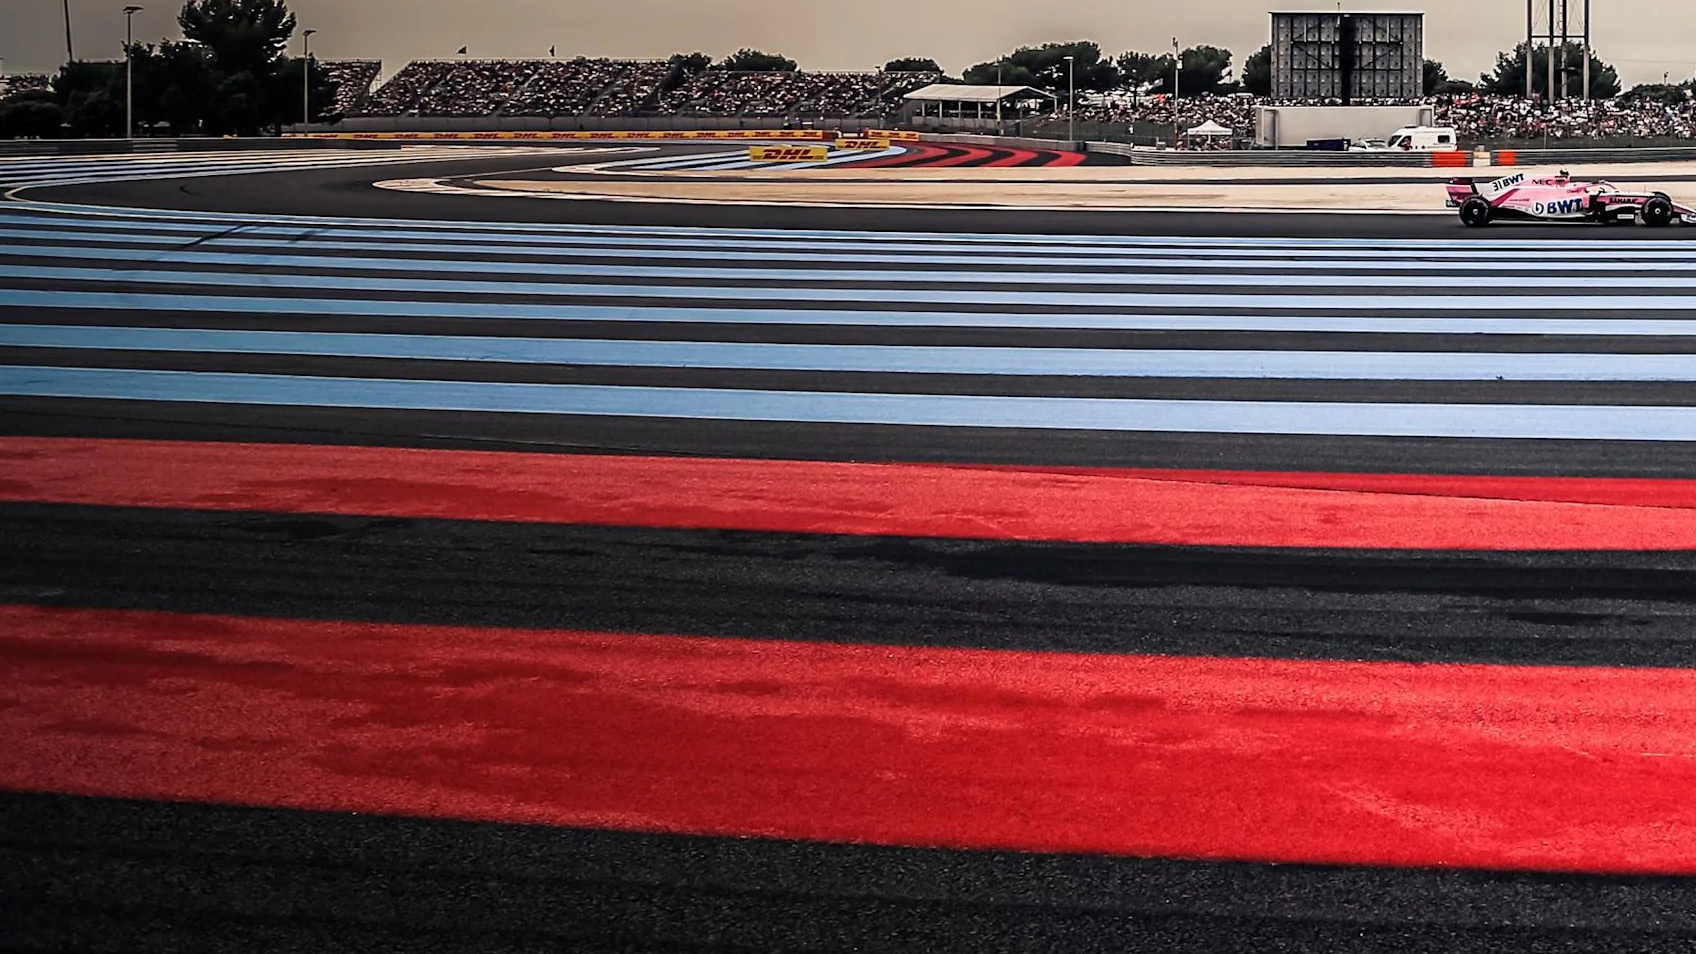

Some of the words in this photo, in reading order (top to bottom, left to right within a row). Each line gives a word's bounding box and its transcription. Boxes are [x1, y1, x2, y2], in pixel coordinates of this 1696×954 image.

[763, 149, 814, 159] DHL
[1492, 180, 1503, 191] 31
[1503, 173, 1525, 188] BWT
[1547, 198, 1583, 214] BWT
